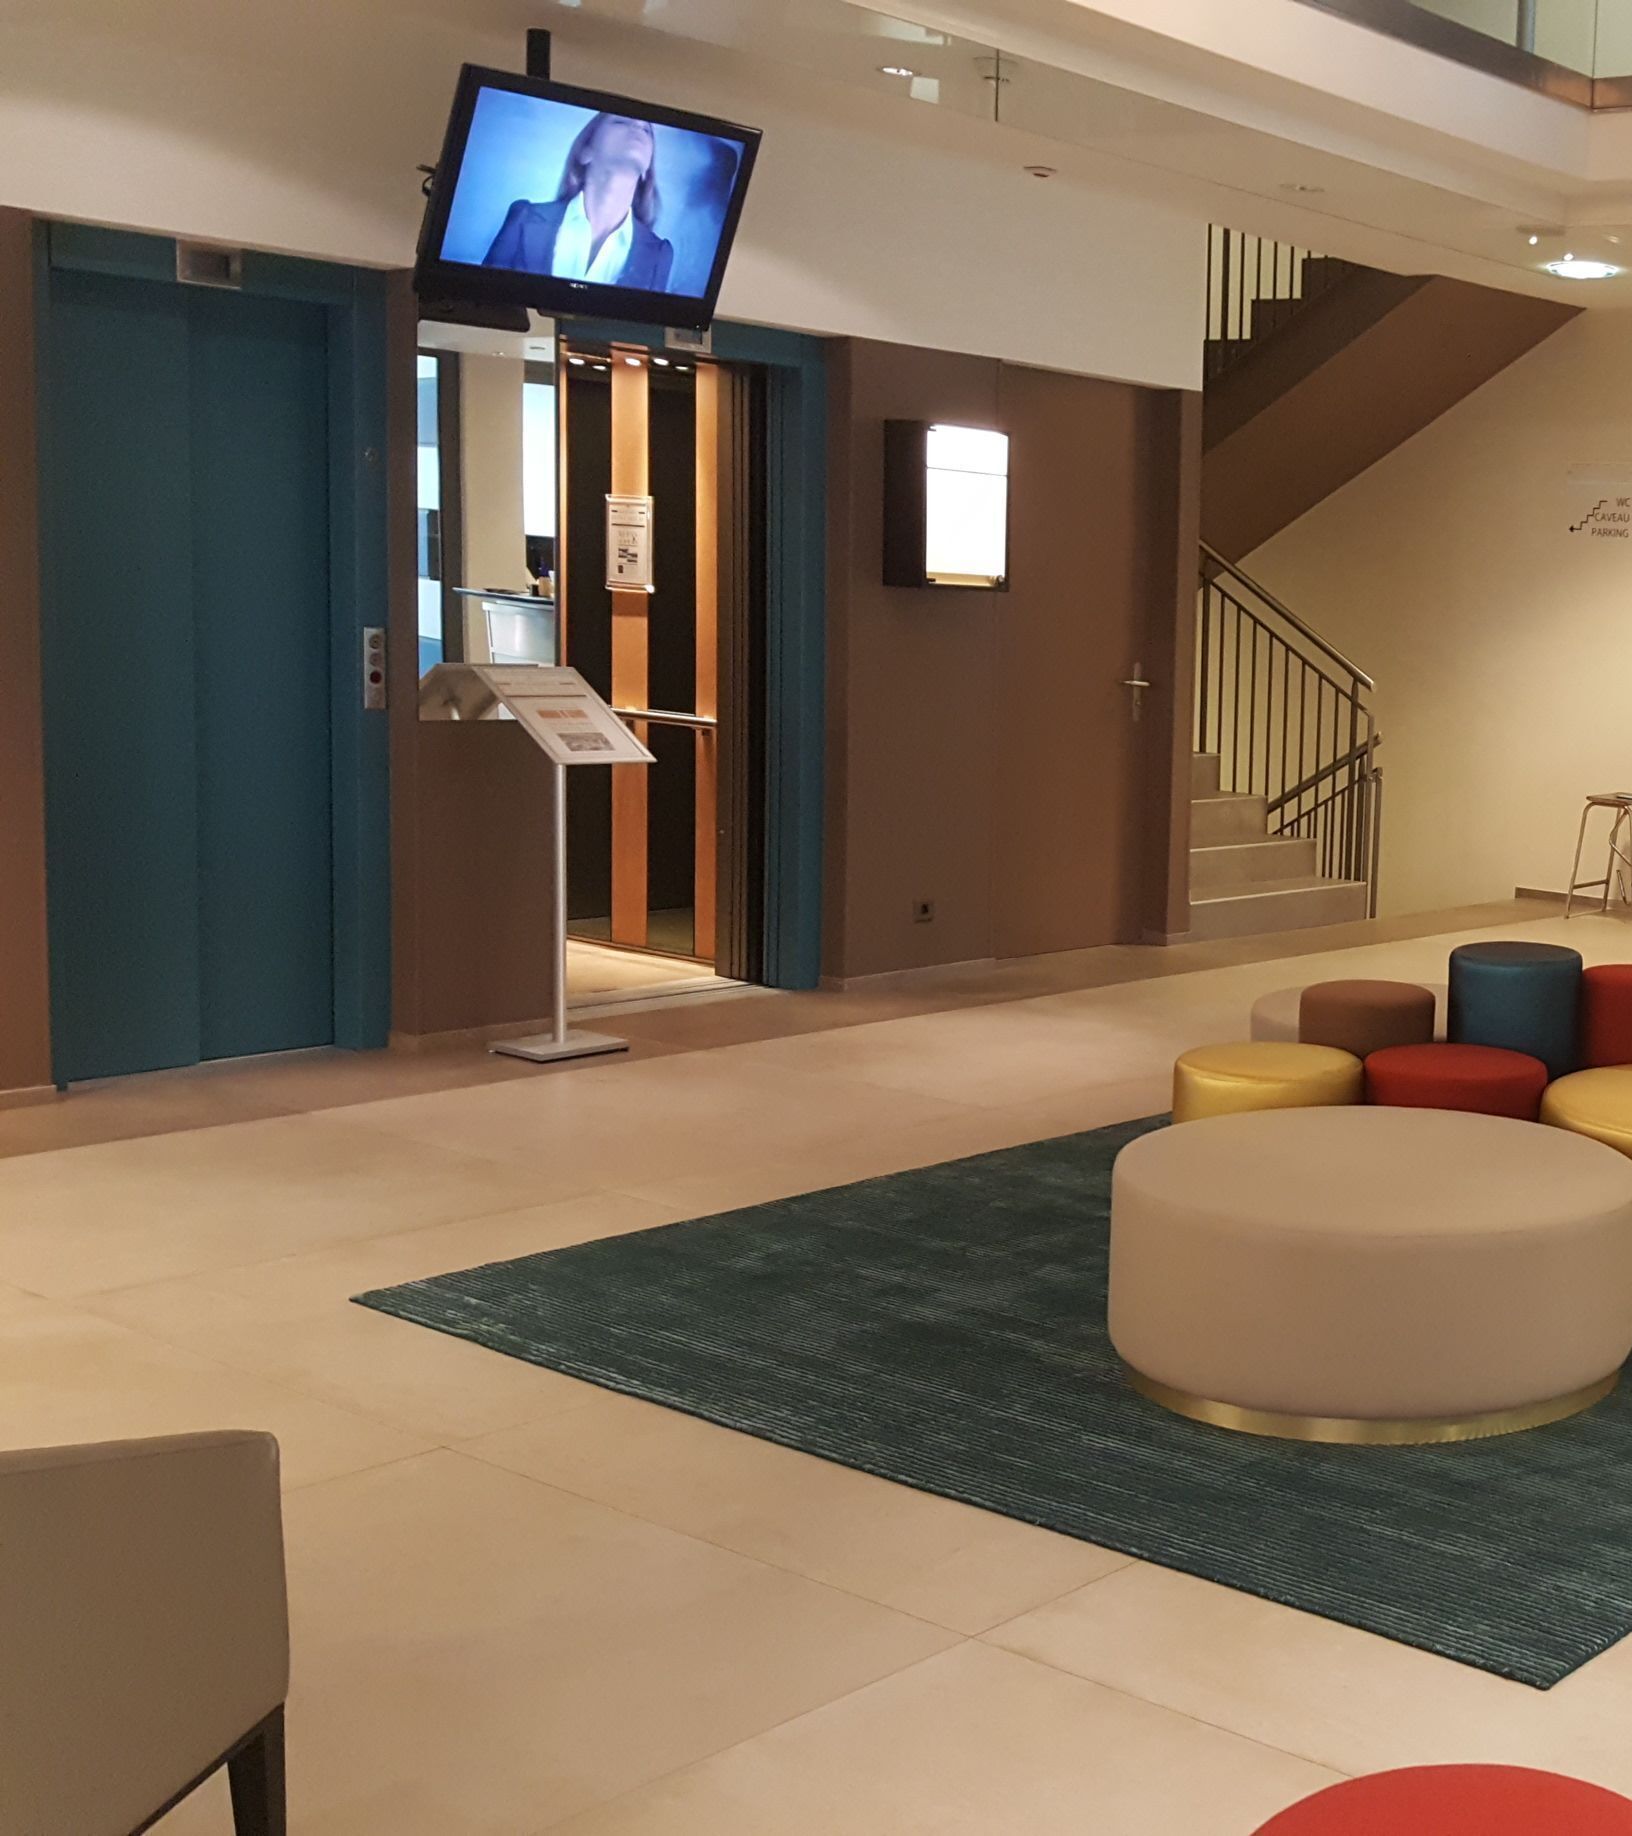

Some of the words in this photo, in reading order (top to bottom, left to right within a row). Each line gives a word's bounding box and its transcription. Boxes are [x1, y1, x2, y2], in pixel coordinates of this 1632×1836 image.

[1616, 497, 1631, 507] WC
[1594, 512, 1630, 523] CAVEAU
[1591, 527, 1629, 538] PARKING
